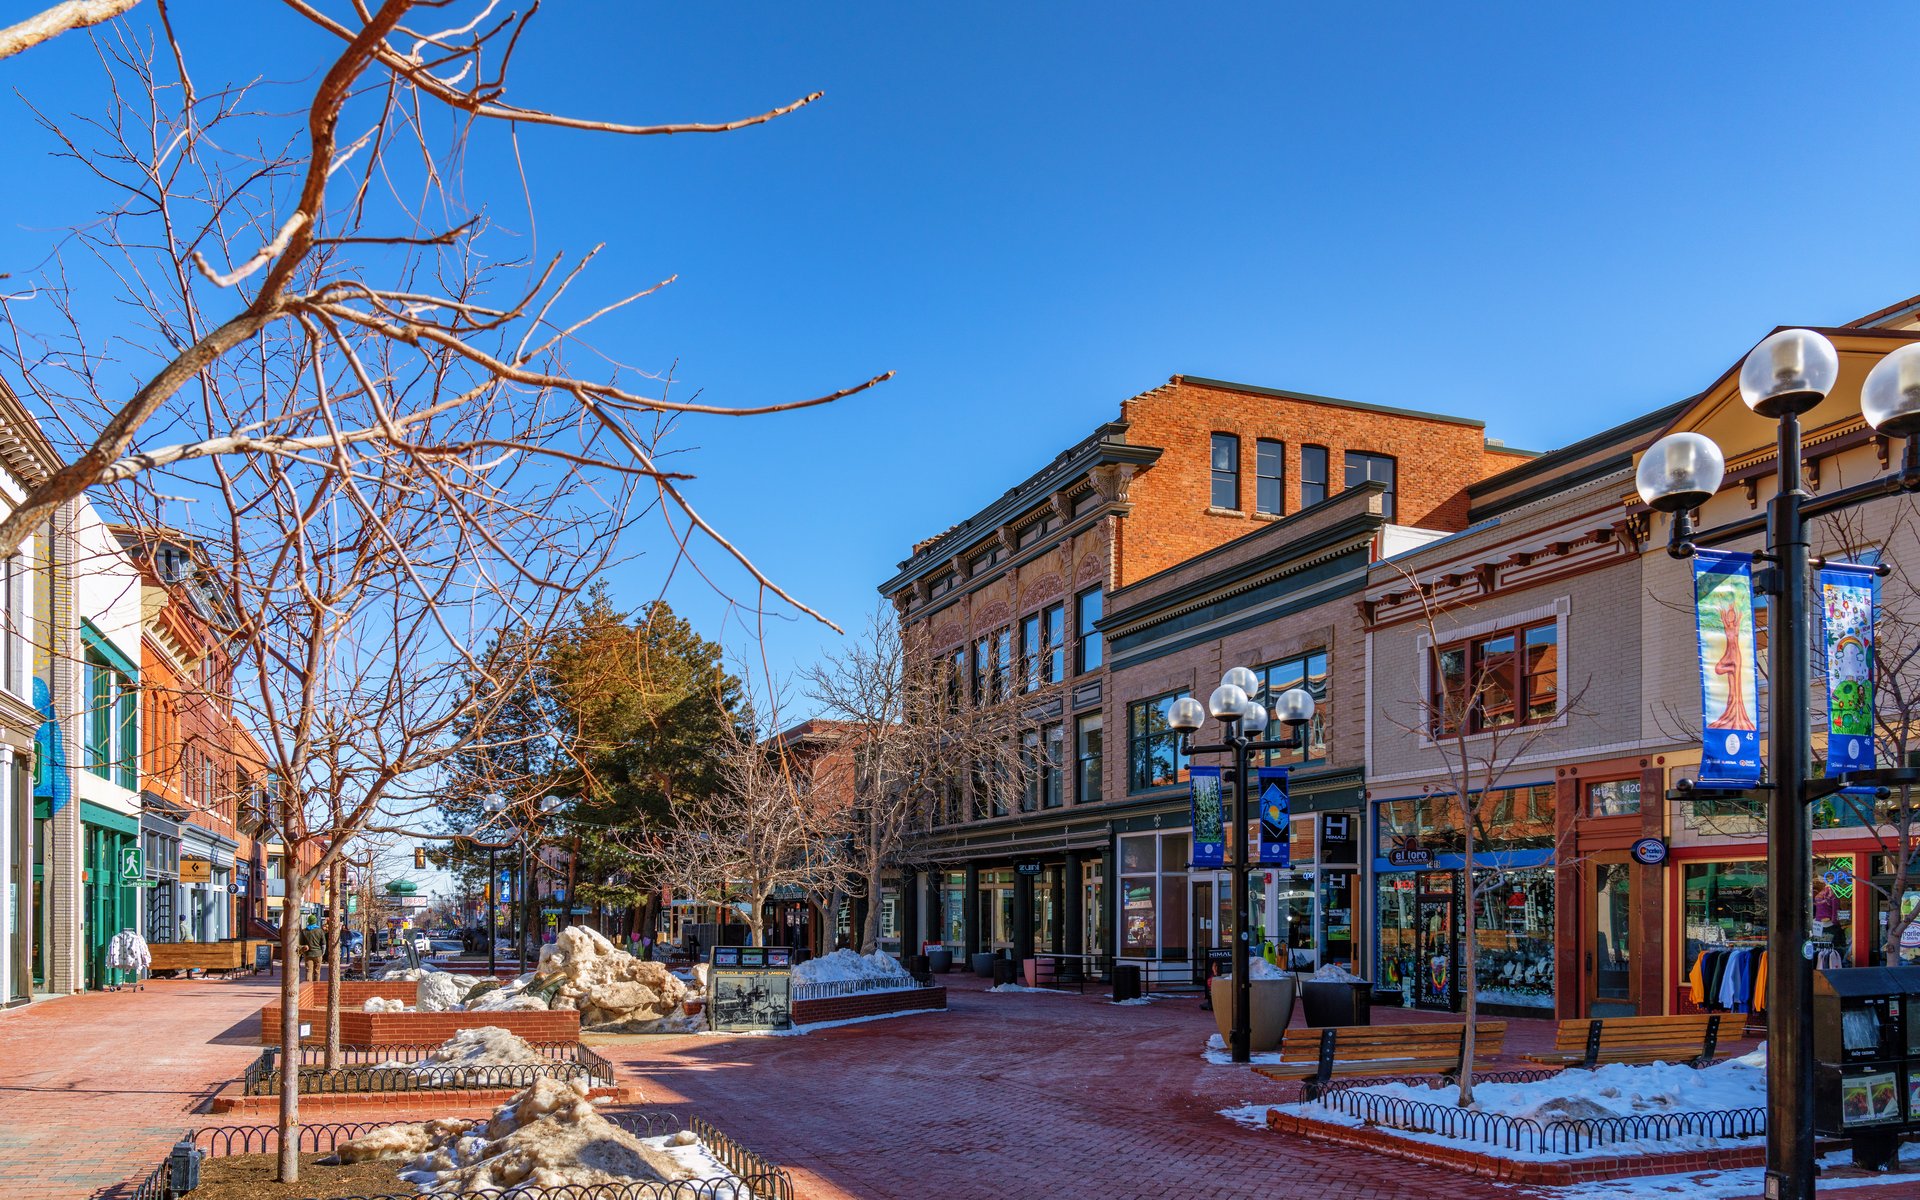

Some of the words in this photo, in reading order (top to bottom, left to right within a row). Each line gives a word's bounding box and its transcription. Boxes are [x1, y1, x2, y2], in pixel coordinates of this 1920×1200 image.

[1745, 732, 1754, 741] 45
[1621, 783, 1640, 794] 1420
[1396, 851, 1405, 860] el
[1407, 851, 1427, 860] loro
[1823, 871, 1853, 885] OPE
